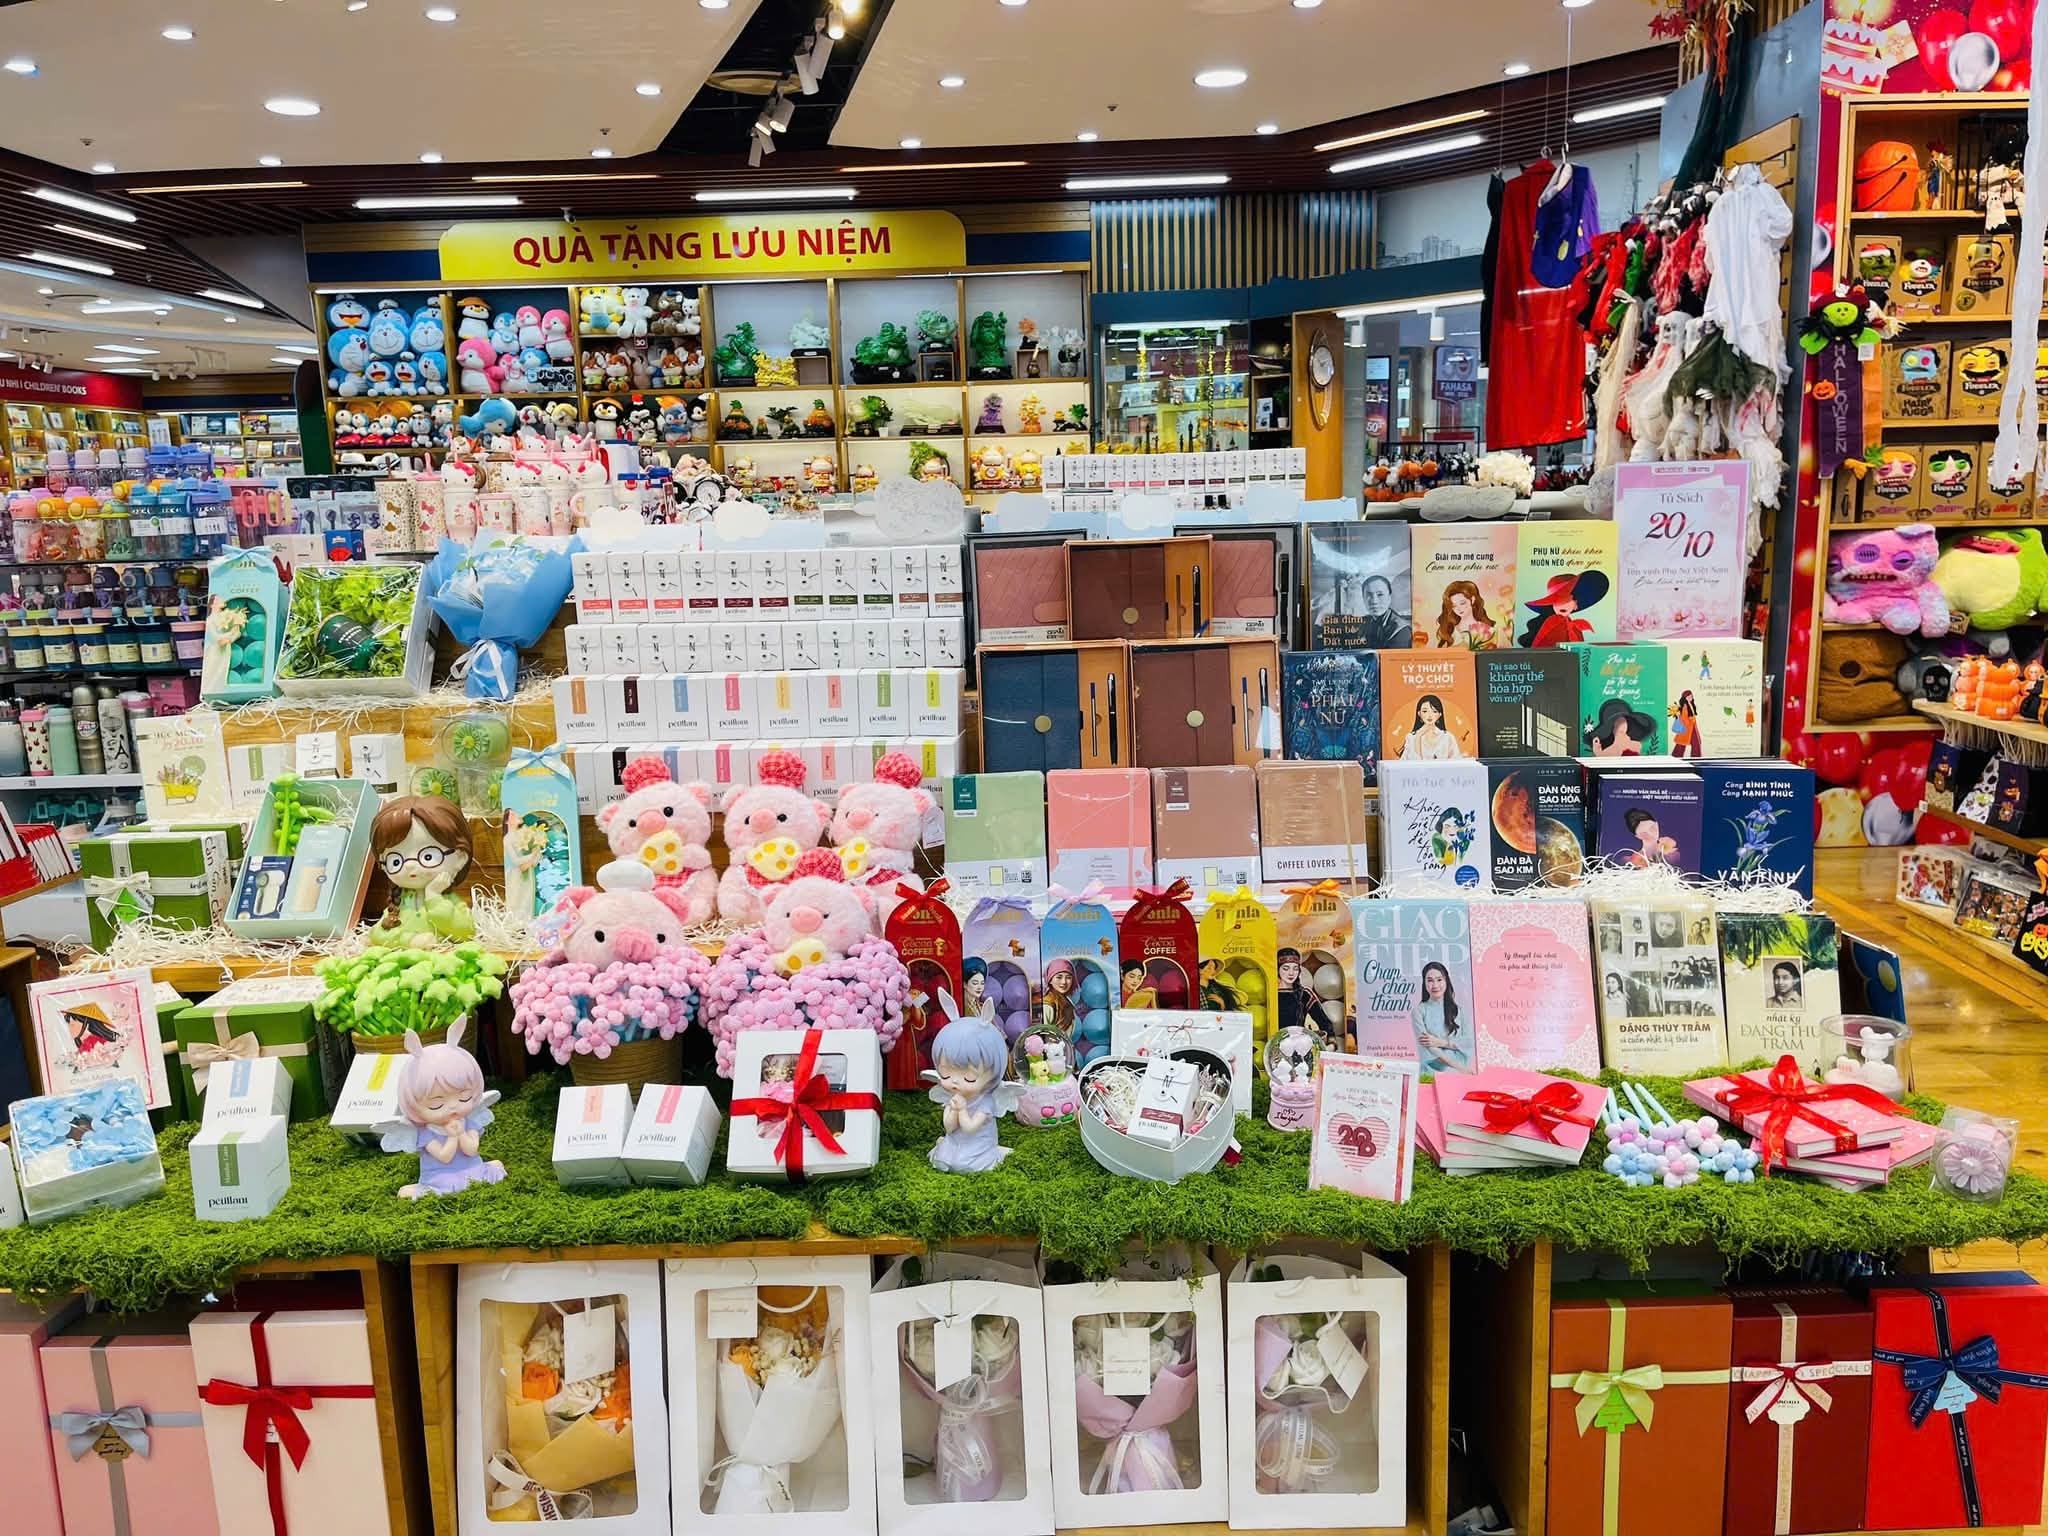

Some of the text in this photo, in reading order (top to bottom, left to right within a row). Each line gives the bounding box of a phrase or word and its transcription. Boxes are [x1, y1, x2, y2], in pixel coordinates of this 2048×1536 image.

[513, 219, 890, 269] QUÀ TẶNG LƯU NIỆM
[24, 381, 60, 392] CHILDREN
[62, 385, 87, 395] BOOKS
[1832, 344, 1848, 454] HALLOWEEN
[1417, 661, 1455, 672] THUYẾT
[1489, 672, 1525, 684] không
[1538, 783, 1580, 794] ĐÀN ÔNG
[1539, 796, 1559, 804] SAO
[1277, 859, 1336, 870] COFFEE LOVERS
[1496, 854, 1533, 865] ĐÀN BÀ
[1494, 866, 1533, 874] SAO KIM
[1215, 905, 1260, 919] nnla
[1292, 899, 1336, 912] nnla
[1357, 905, 1467, 940] GIAO
[902, 948, 934, 956] COFFEE
[1144, 947, 1176, 955] COFFEE
[1222, 946, 1255, 954] COFFEE
[1358, 927, 1469, 977] TIẾP
[1364, 960, 1401, 984] Chạm
[1382, 979, 1416, 995] chân
[1368, 992, 1412, 1012] thành
[1620, 1022, 1650, 1034] ĐẶNG
[1682, 1021, 1711, 1032] TRÂM
